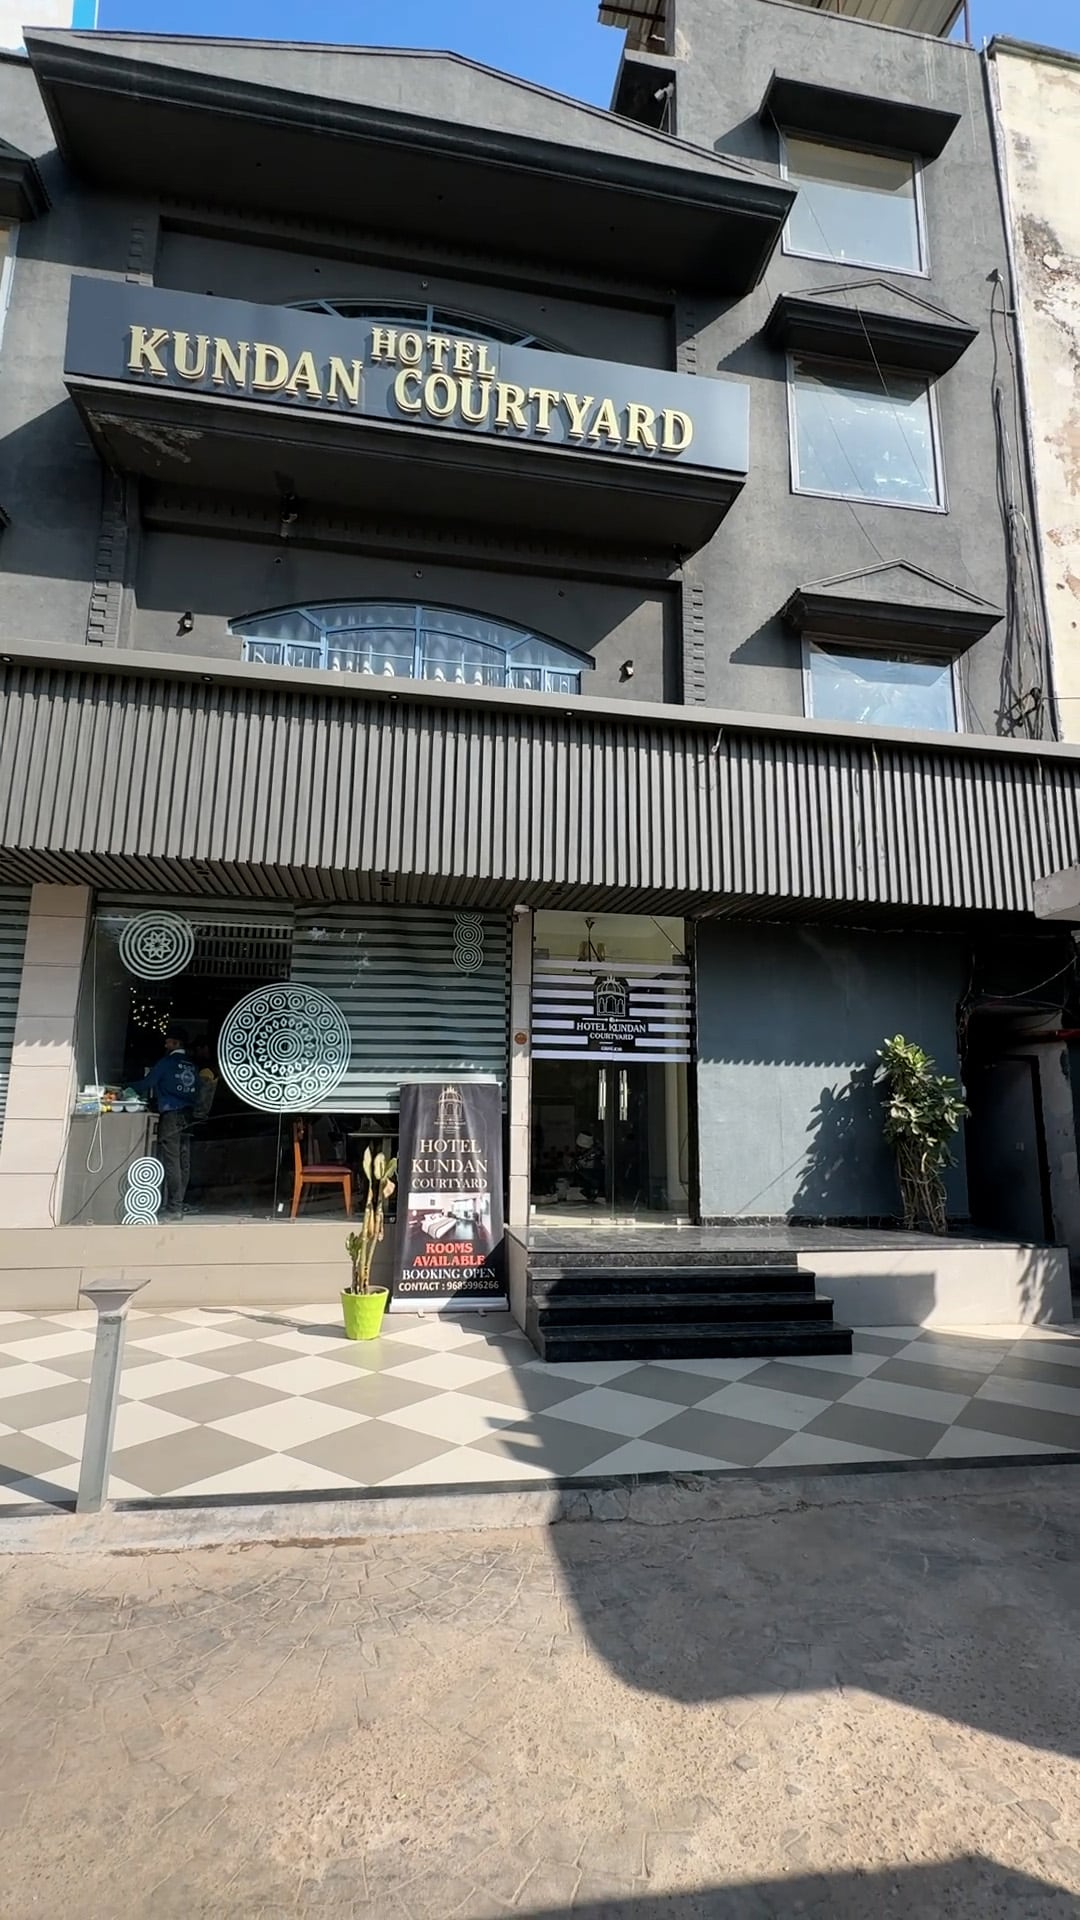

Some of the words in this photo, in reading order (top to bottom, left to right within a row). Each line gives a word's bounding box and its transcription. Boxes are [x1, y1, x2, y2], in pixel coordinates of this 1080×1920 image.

[370, 327, 497, 376] HOTEL
[127, 325, 364, 406] KUNDAN
[393, 369, 694, 454] COURTYARD
[576, 1022, 607, 1032] HOTEL
[609, 1023, 647, 1033] KUNDAN
[589, 1032, 634, 1041] COURTYARD
[419, 1139, 482, 1154] HOTEL
[411, 1159, 488, 1174] KUNDAN
[411, 1178, 488, 1190] COURTYARD
[425, 1242, 474, 1254] ROOMS
[413, 1254, 486, 1267] AVAILABLE
[402, 1268, 460, 1280] BOOKING
[463, 1268, 496, 1279] OPEN
[398, 1282, 440, 1292] CONTACT
